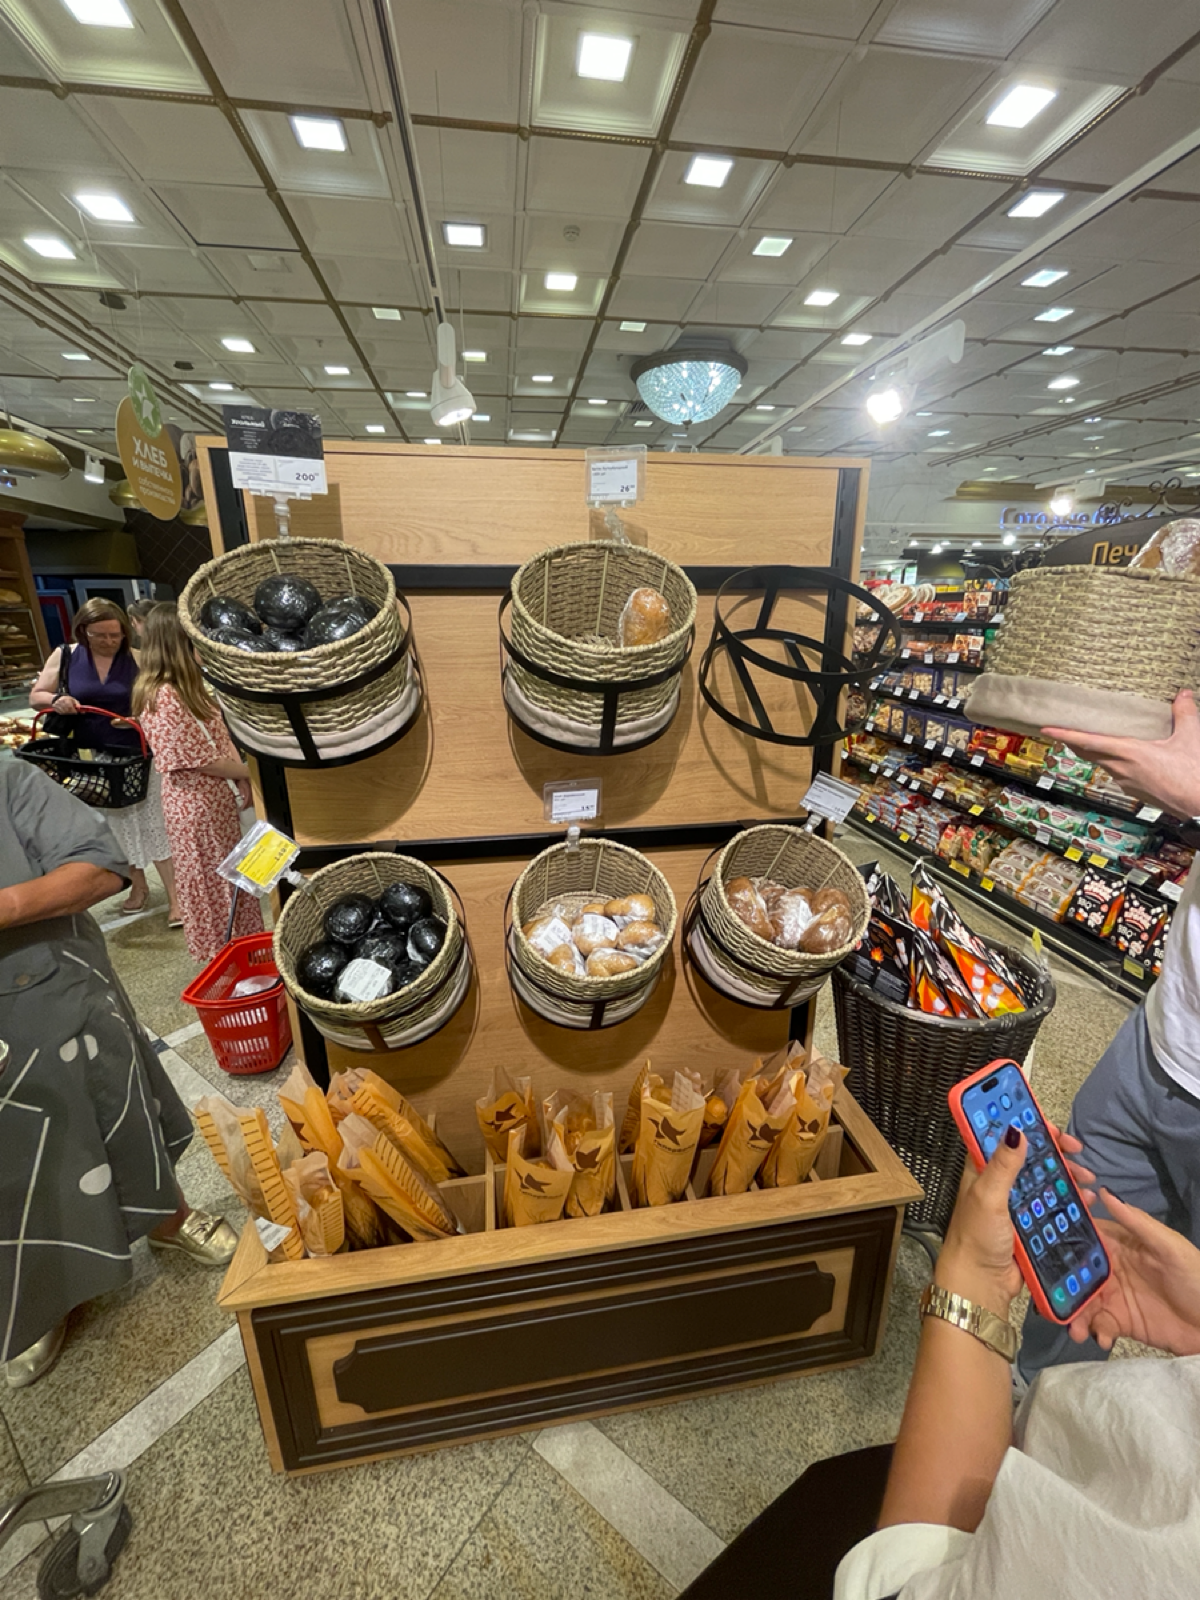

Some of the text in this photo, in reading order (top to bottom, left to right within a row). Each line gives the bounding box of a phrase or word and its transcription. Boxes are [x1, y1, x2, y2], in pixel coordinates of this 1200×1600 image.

[132, 436, 168, 468] ХЛЕБ
[132, 456, 174, 483] И ВЫПЕЧКА
[1091, 541, 1139, 566] Печ
